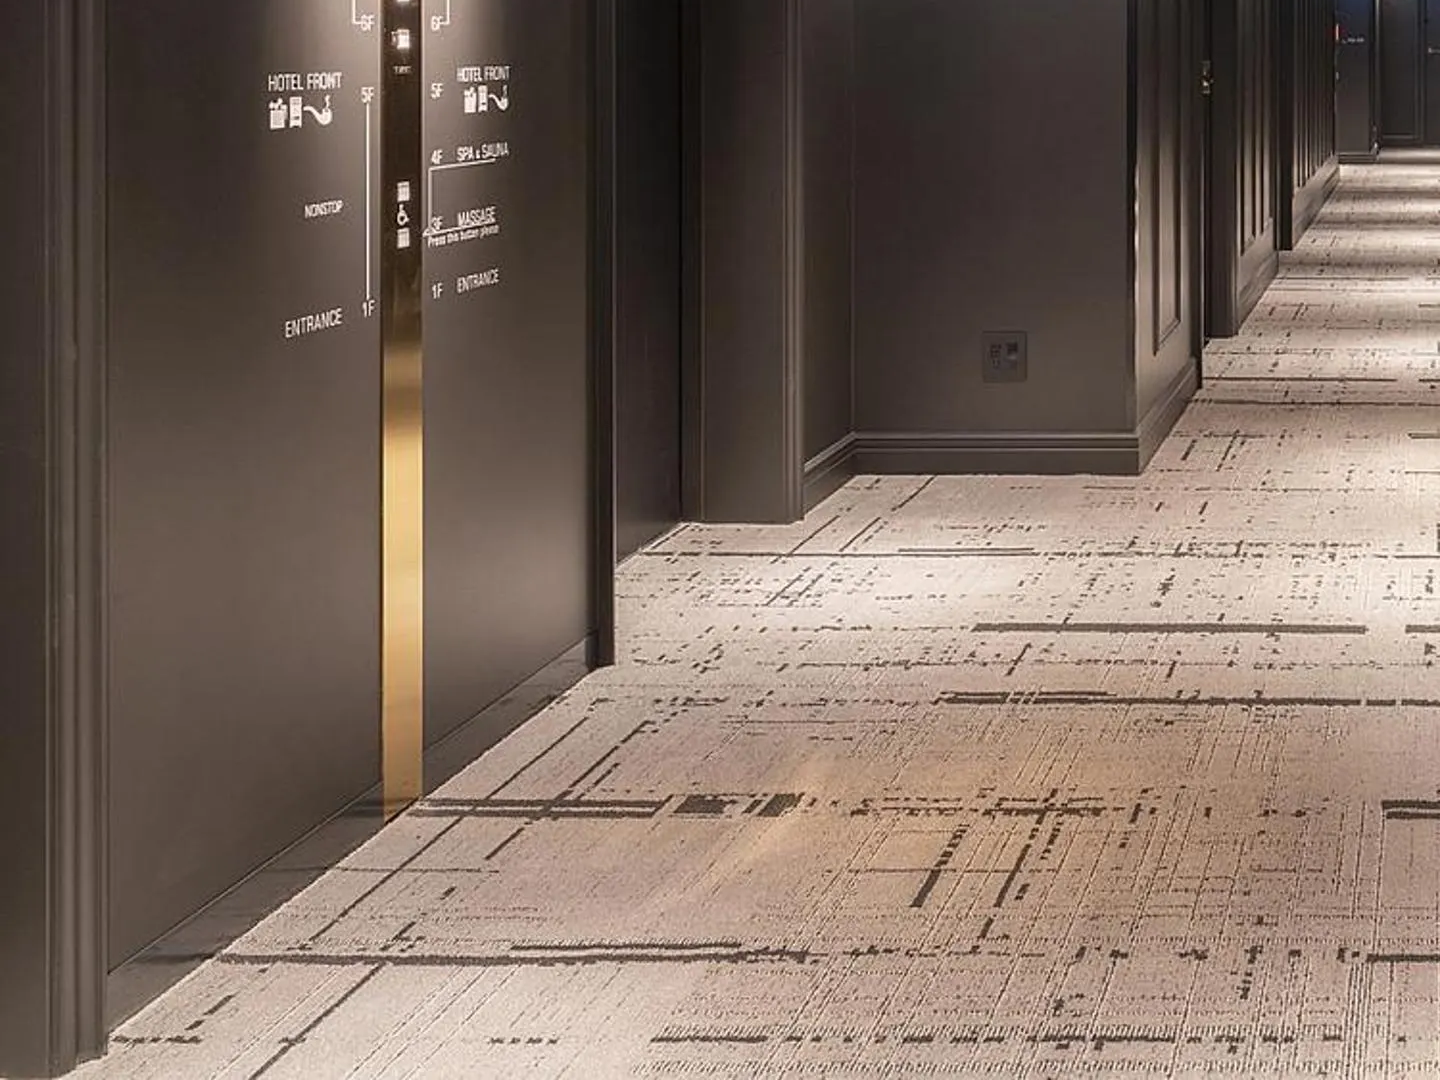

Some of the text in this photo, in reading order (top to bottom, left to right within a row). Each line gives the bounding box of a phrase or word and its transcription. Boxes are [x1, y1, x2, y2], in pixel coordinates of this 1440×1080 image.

[268, 71, 342, 92] HOTEL FRONT
[456, 65, 511, 82] HOTEL FRONT
[361, 86, 375, 104] 5F
[430, 83, 444, 99] 5F
[431, 149, 443, 165] 4F
[456, 146, 474, 162] SPA
[481, 141, 509, 159] SAUNA
[304, 200, 343, 219] NONSTOP
[457, 205, 496, 227] MASSAGE
[432, 268, 500, 299] 1F ENTRANCE
[284, 299, 376, 338] ENTRANCE 1F
